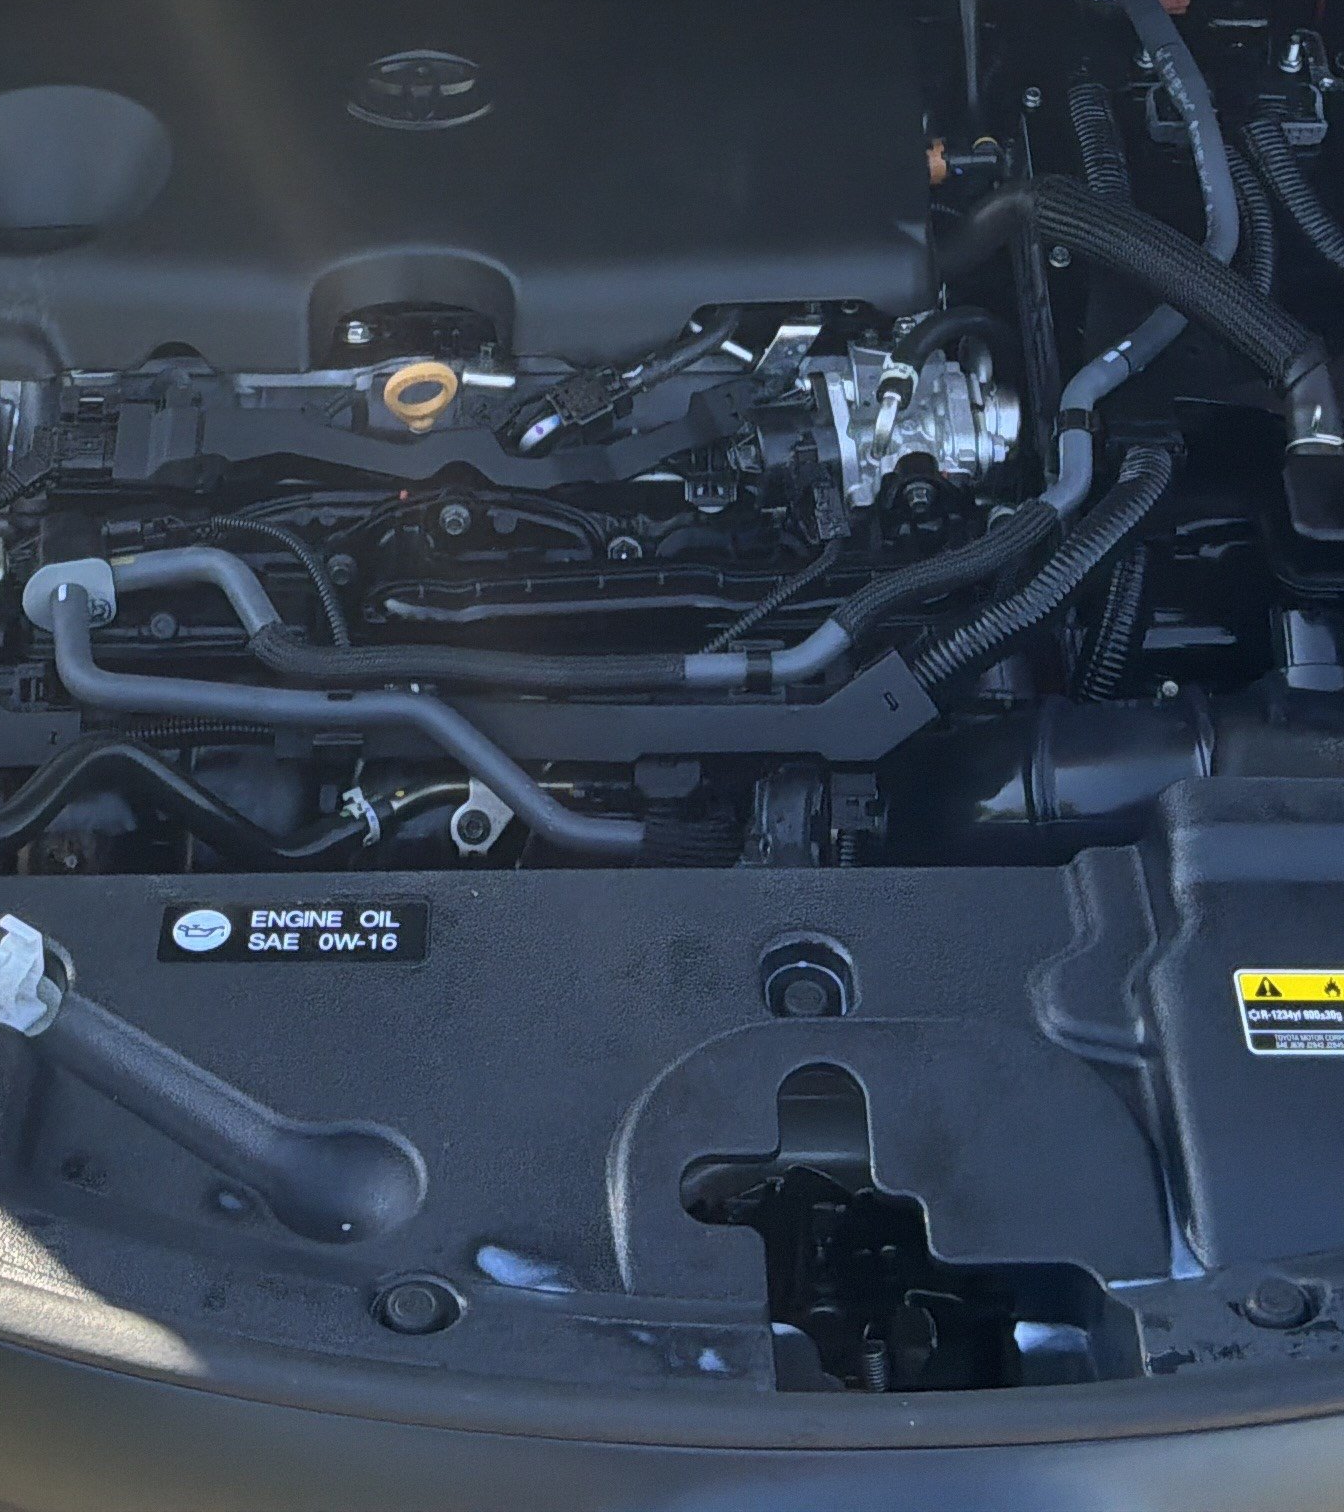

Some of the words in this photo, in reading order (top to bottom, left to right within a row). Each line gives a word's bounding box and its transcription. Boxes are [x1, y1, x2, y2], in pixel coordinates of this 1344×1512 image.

[250, 910, 343, 928] ENGINE
[359, 910, 400, 928] OIL
[247, 933, 299, 951] SAE
[318, 933, 398, 951] 0W-16
[1274, 1034, 1299, 1042] TOYOTA
[1300, 1034, 1324, 1042] MOTOR
